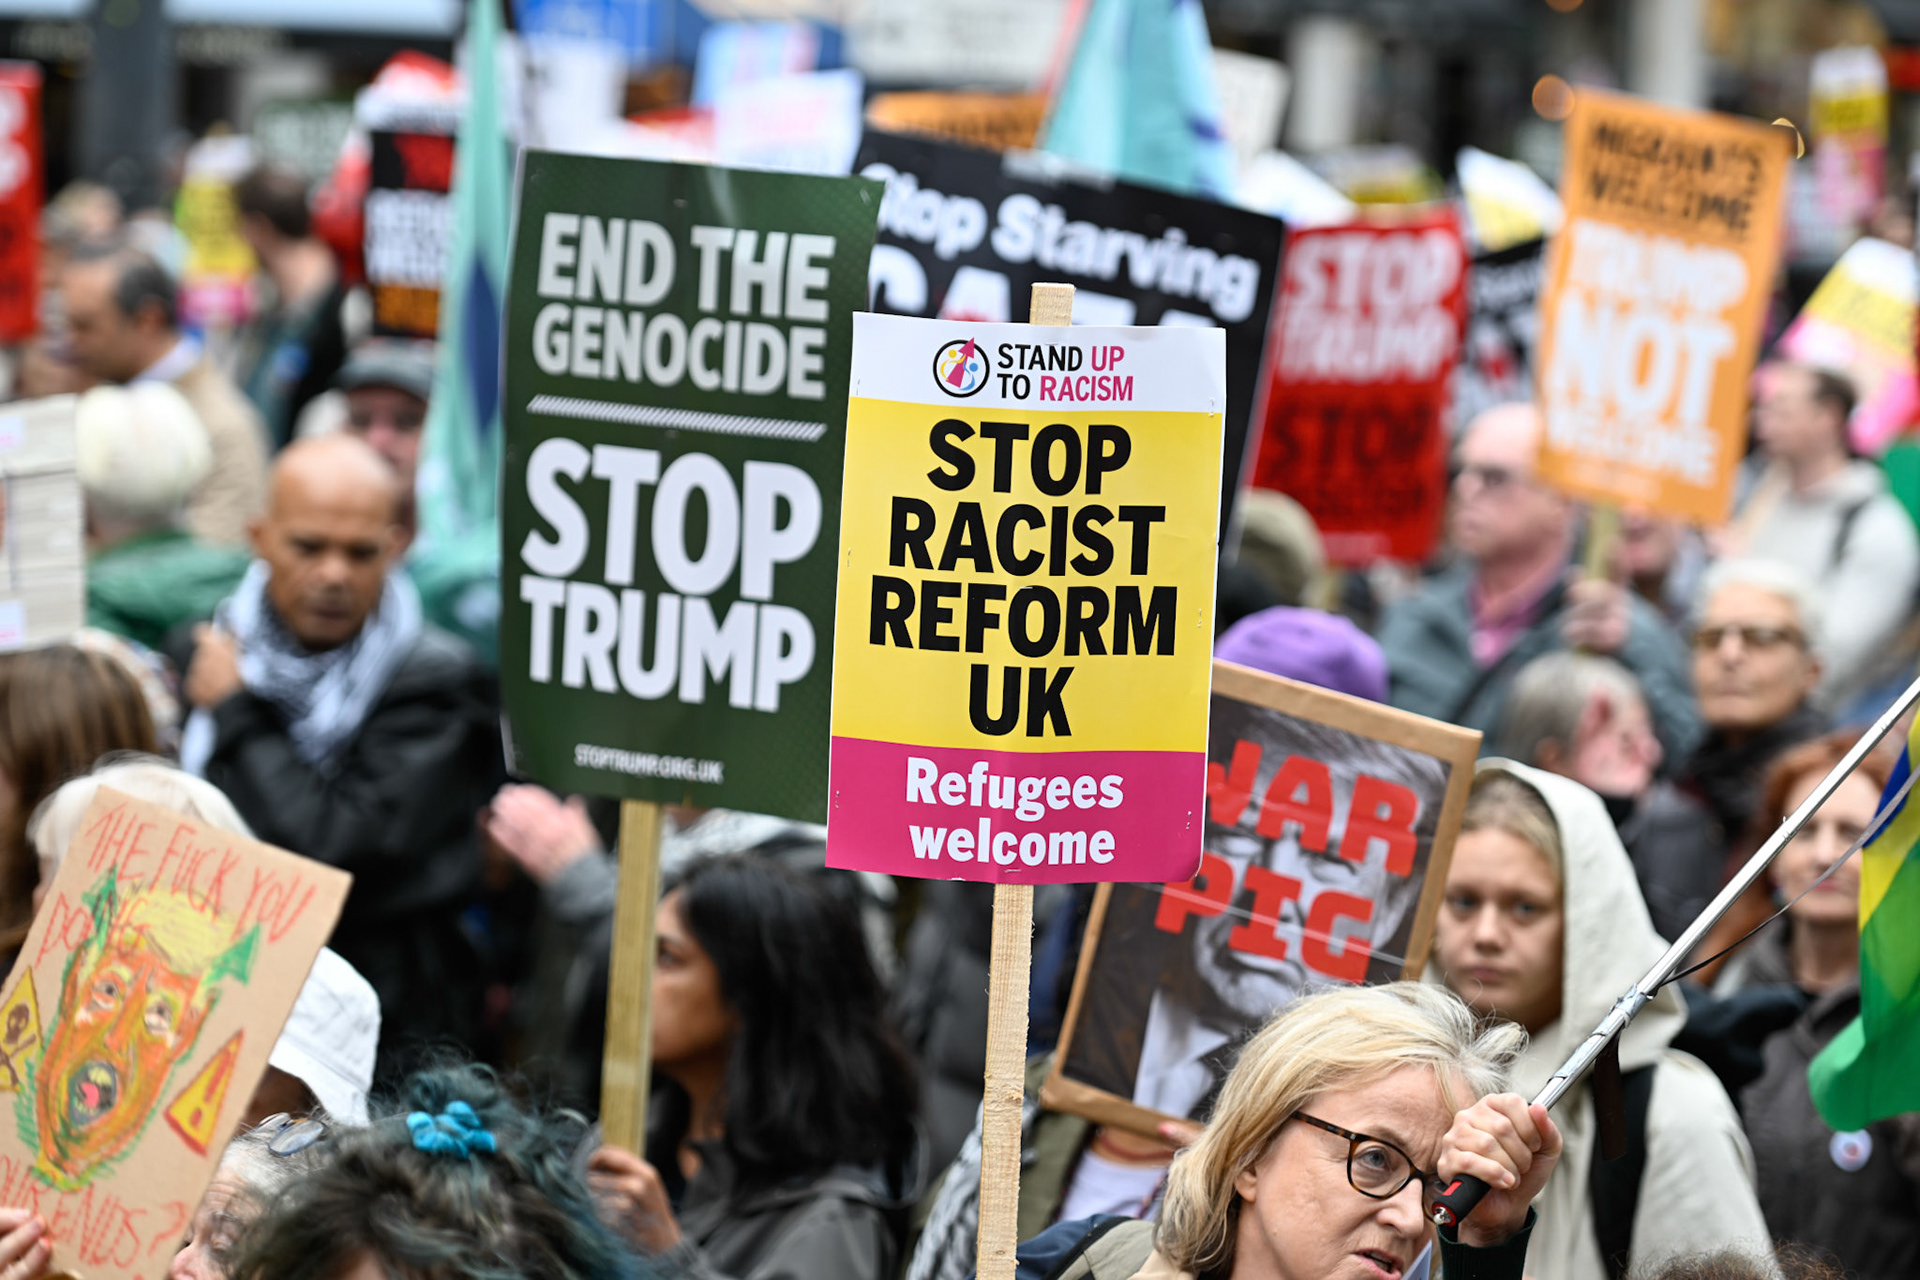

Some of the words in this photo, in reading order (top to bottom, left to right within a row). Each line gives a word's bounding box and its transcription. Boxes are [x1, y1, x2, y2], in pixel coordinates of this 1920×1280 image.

[537, 211, 677, 307] END
[690, 224, 837, 323] THE
[992, 193, 1261, 322] Starving
[1287, 231, 1463, 308] STOP
[532, 302, 827, 400] GENOCIDE
[996, 373, 1031, 400] TO
[1039, 375, 1134, 402] RACISM
[997, 343, 1083, 372] STAND
[1091, 345, 1125, 372] UP
[1545, 286, 1736, 425] NOT
[926, 418, 1132, 497] STOP
[520, 437, 823, 602] STOP
[889, 496, 1166, 577] RACIST
[519, 573, 817, 713] TRUMP
[869, 574, 1178, 658] REFORM
[969, 663, 1075, 738] UK
[905, 756, 1124, 822] Refugees
[1206, 739, 1419, 877] WAR
[84, 801, 158, 882] THE
[147, 822, 242, 924] FUCK
[229, 866, 318, 944] YOU
[908, 817, 1116, 866] welcome
[1154, 855, 1375, 984] PIG
